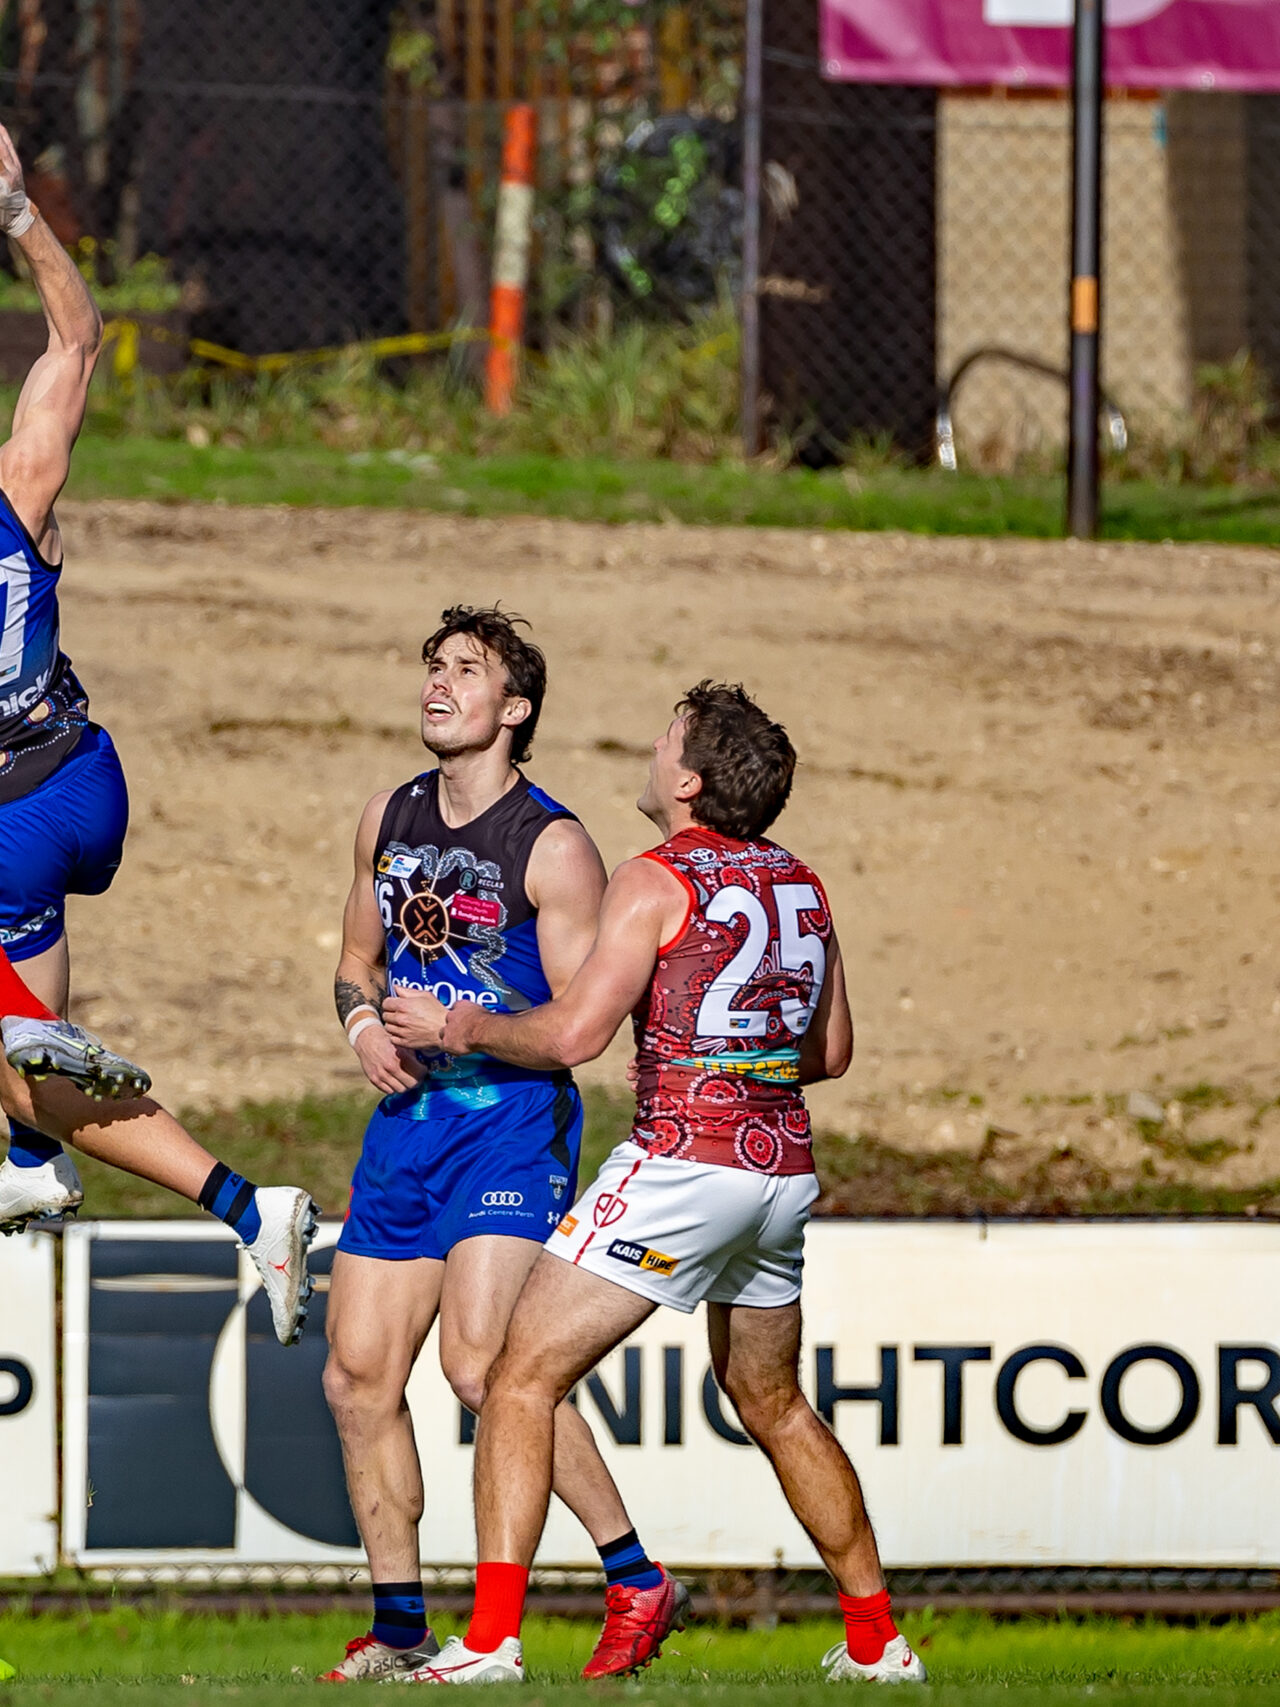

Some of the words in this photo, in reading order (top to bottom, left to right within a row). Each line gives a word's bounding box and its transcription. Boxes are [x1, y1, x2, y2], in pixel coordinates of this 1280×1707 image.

[697, 884, 826, 1036] 25
[612, 1243, 643, 1260] KAIS
[646, 1254, 673, 1270] HIRE
[373, 1654, 410, 1675] asics
